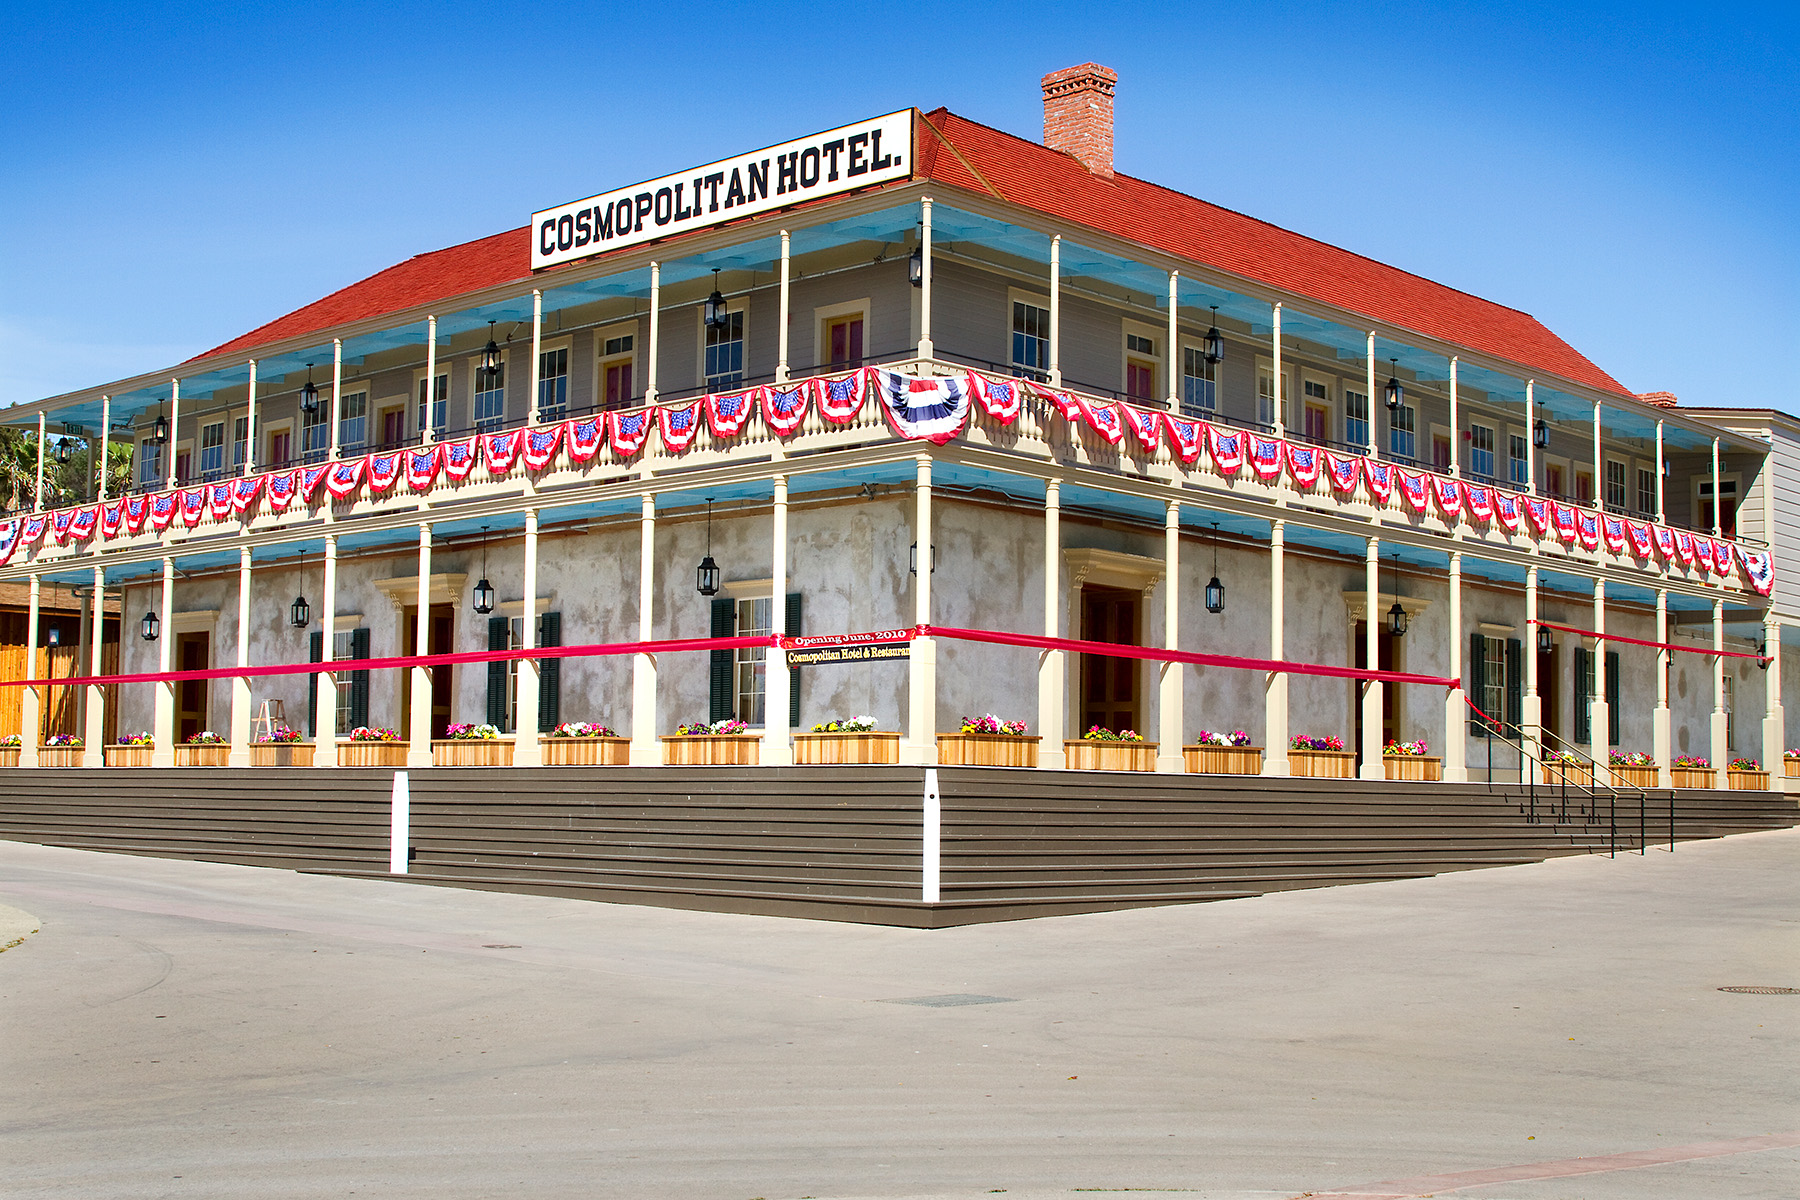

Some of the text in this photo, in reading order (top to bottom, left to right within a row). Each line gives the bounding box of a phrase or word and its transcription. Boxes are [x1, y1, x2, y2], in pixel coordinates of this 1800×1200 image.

[540, 128, 902, 257] COSMOPOLITAN HOTEL.
[795, 636, 842, 646] Opening
[842, 633, 875, 642] June,
[875, 630, 907, 640] 2010
[788, 646, 910, 665] Cosmopolitan Hotel & Restauran
